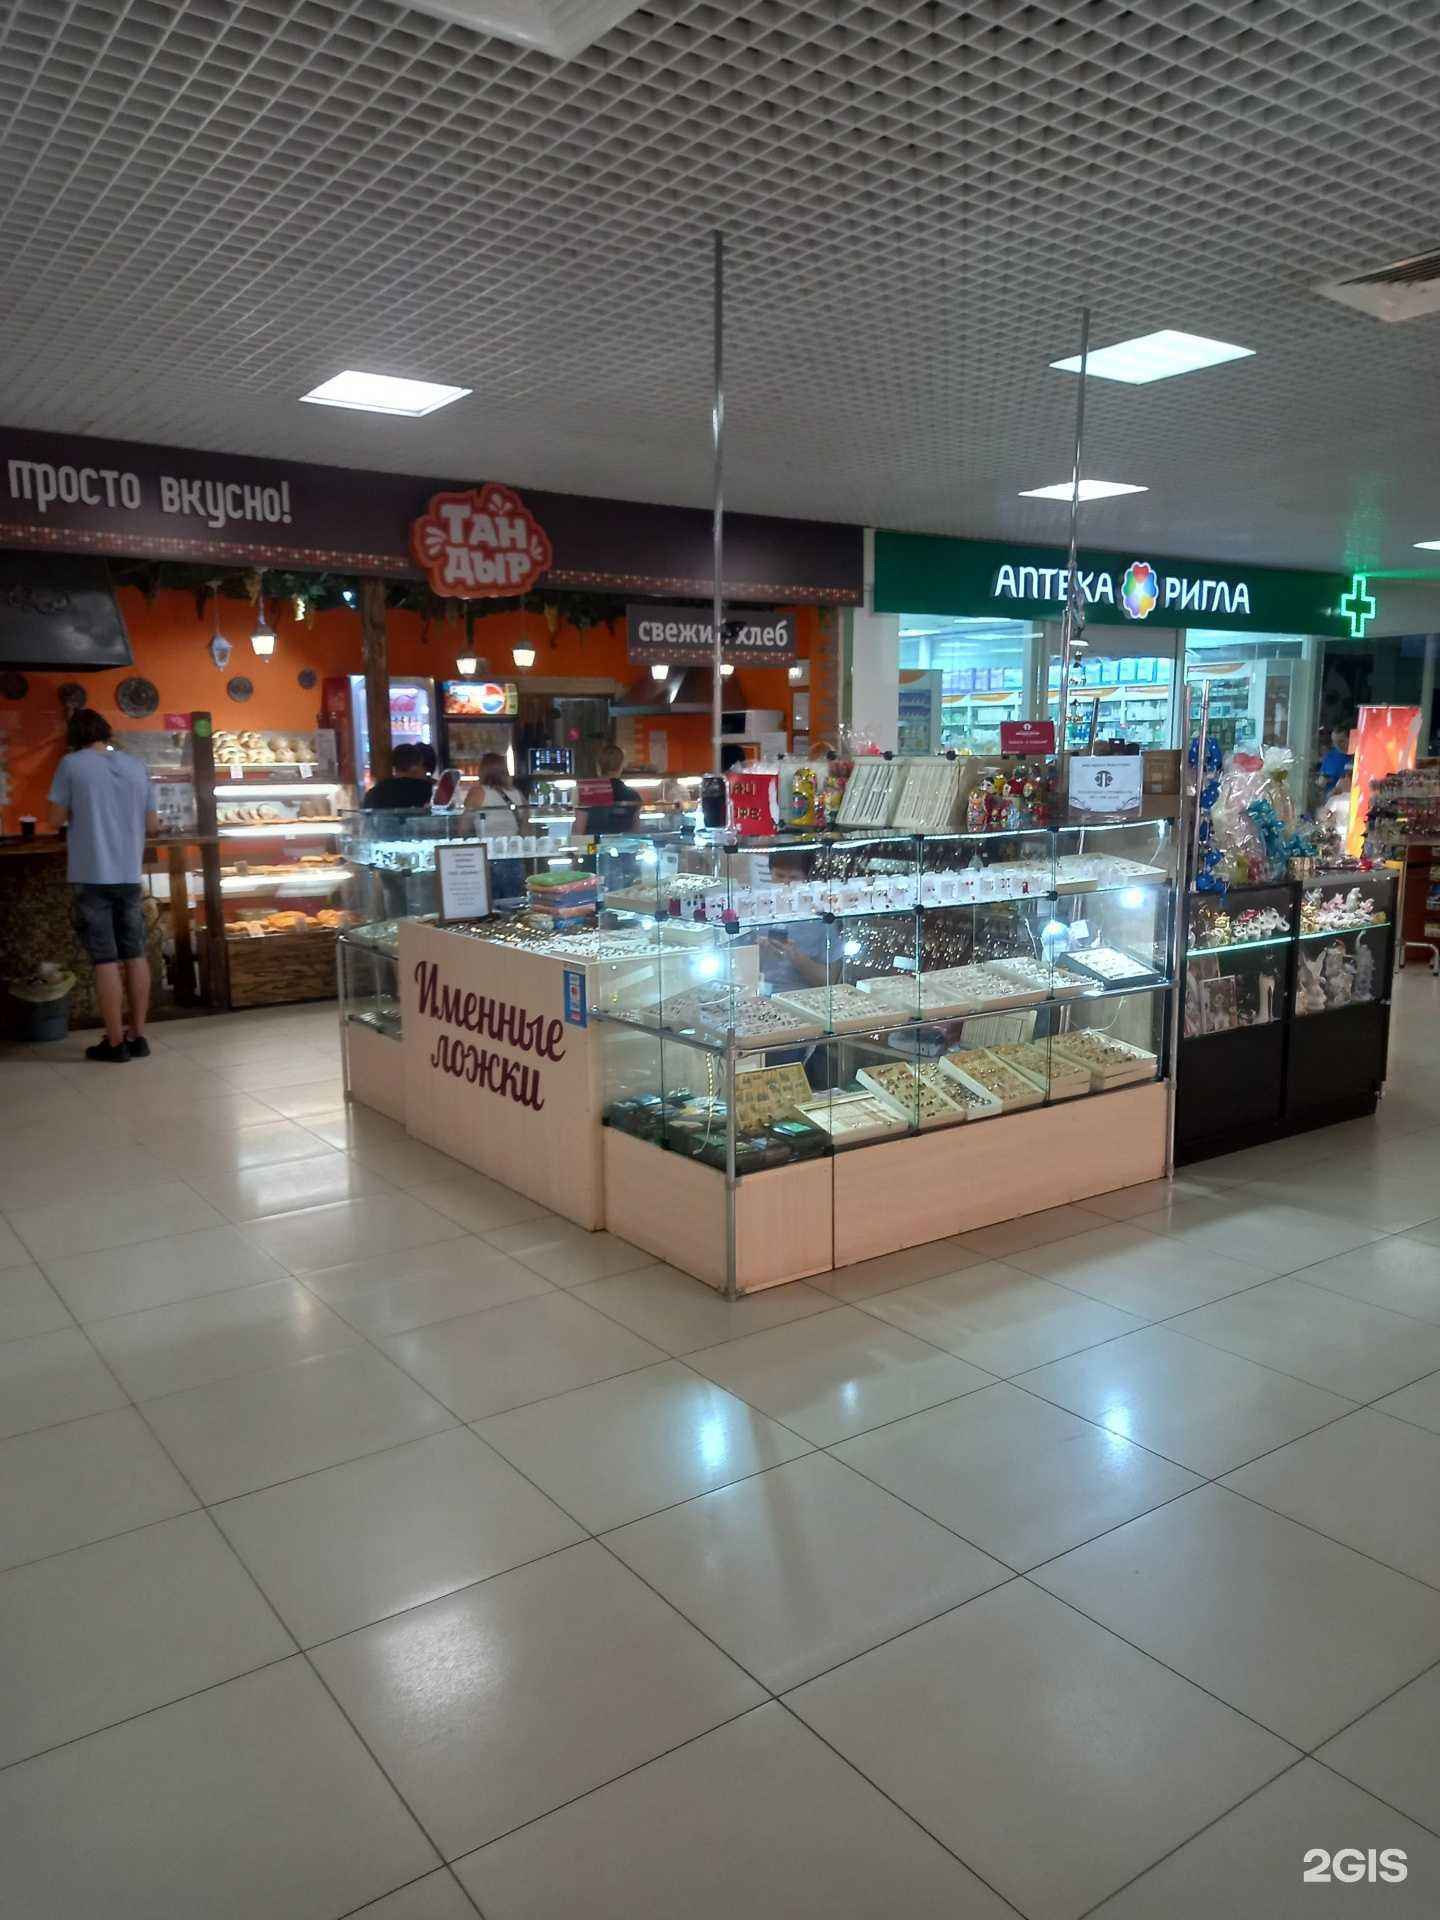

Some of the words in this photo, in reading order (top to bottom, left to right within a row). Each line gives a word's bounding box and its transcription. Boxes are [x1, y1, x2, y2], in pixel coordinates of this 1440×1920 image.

[440, 503, 528, 549] ТАН
[444, 546, 531, 586] ДЫР
[994, 564, 1115, 604] АПТЕКА
[1164, 576, 1251, 614] РИГЛА
[638, 619, 731, 646] свежи
[735, 620, 788, 647] хлеб
[414, 960, 566, 1062] Именные
[430, 1034, 545, 1112] ложки
